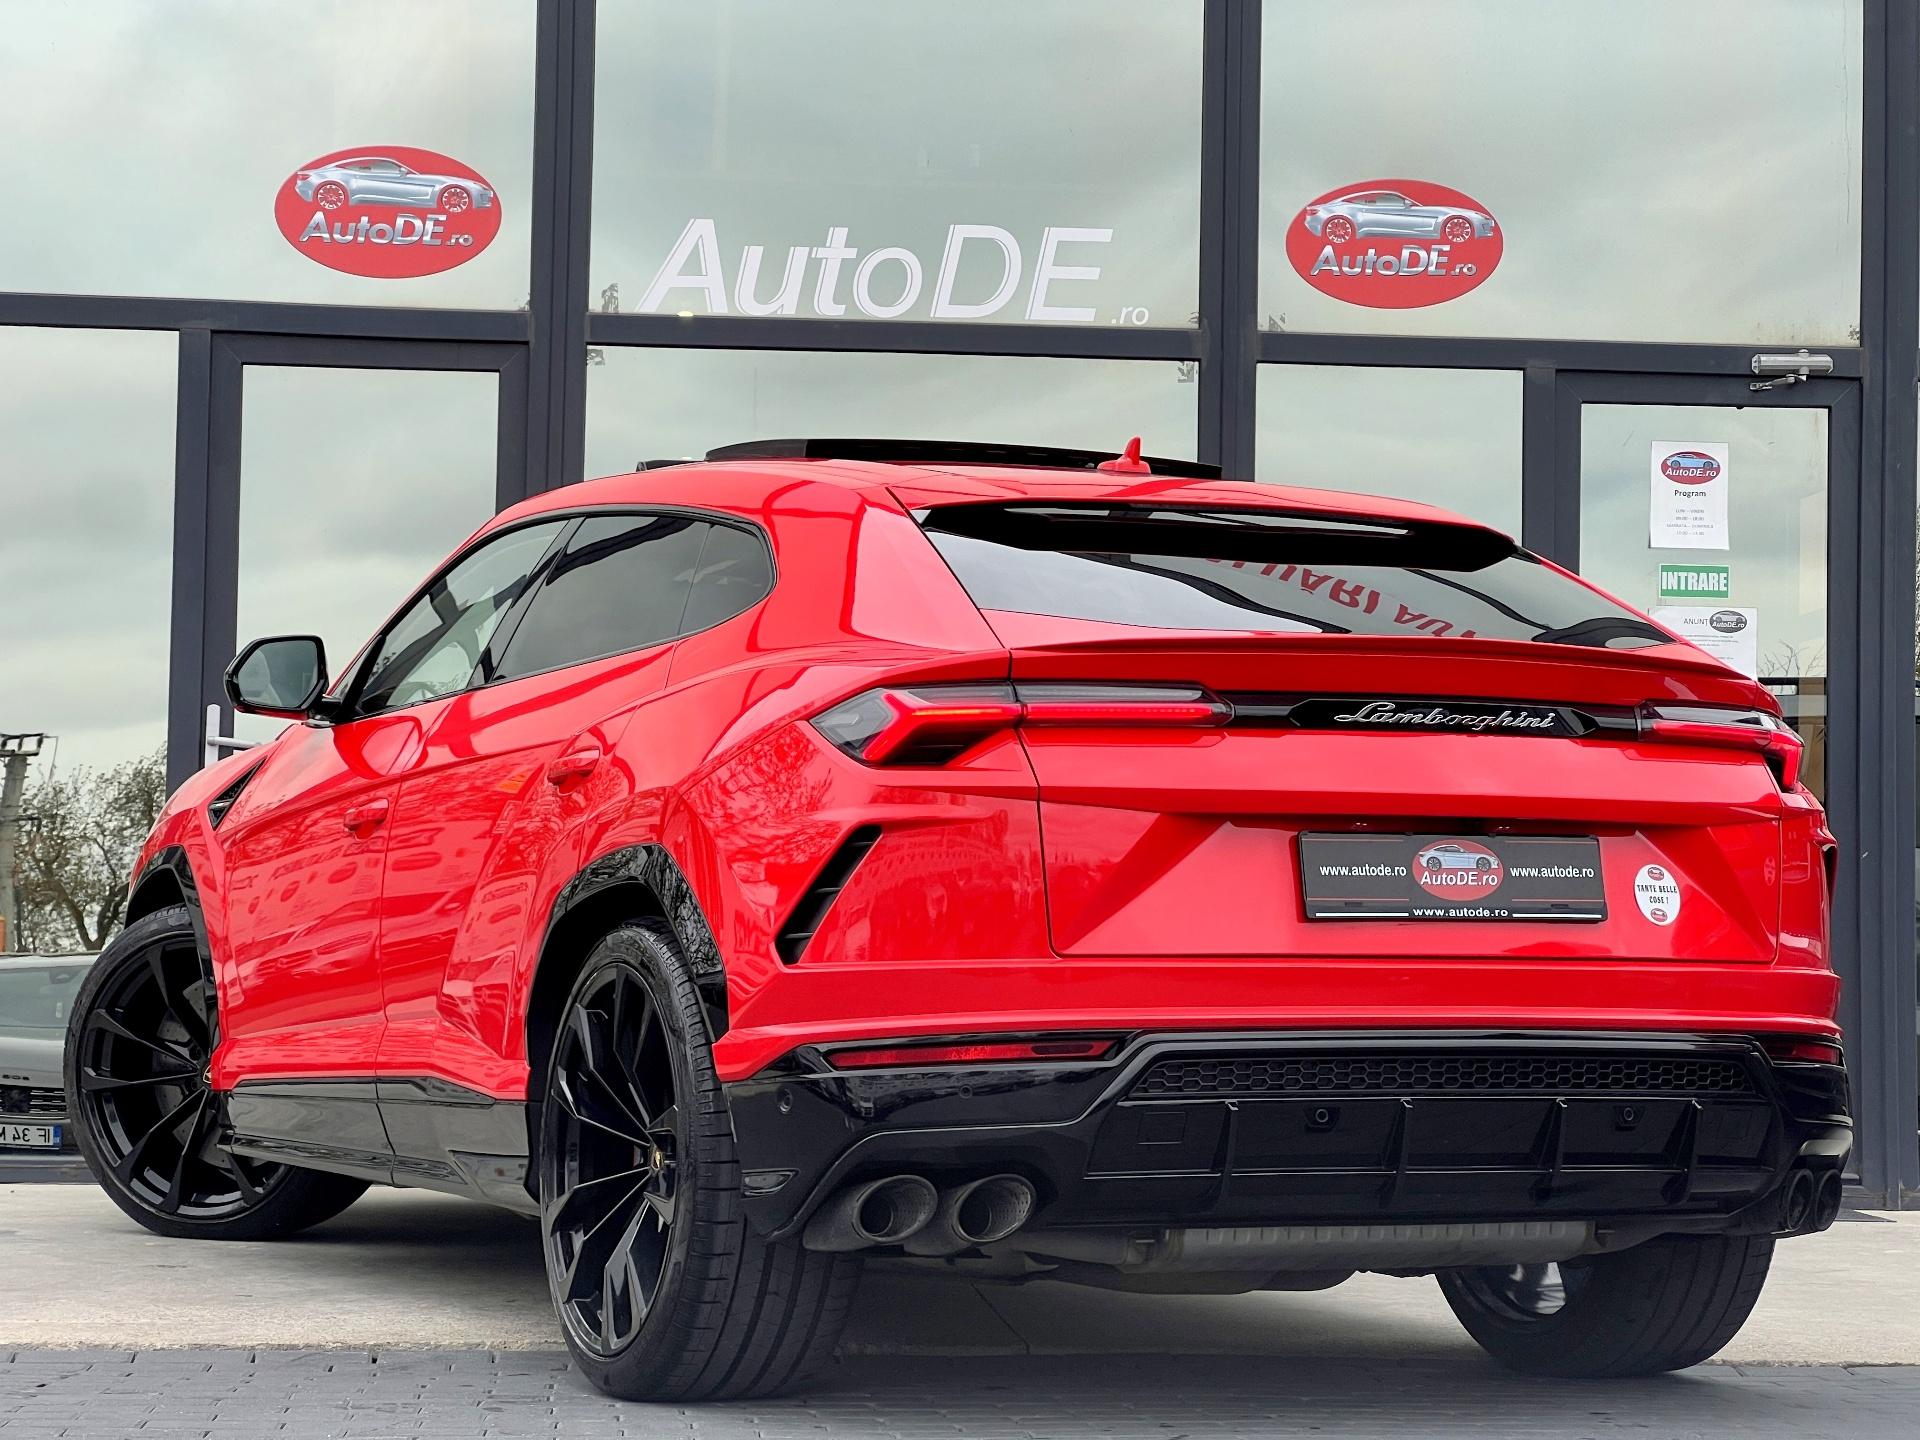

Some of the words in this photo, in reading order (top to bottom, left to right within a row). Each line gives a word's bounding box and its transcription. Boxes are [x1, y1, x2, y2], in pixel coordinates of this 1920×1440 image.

[1664, 467, 1717, 477] AutoDE.ro
[1674, 489, 1706, 498] Program
[1661, 571, 1727, 591] INTRARE
[1333, 702, 1554, 730] Lamborghini
[1319, 864, 1407, 876] www.autode.ro
[1510, 865, 1594, 878] www.autode.ro
[1420, 871, 1498, 886] AutoDE.ro
[1637, 884, 1657, 893] TANTE
[1659, 885, 1677, 893] BELLE
[1649, 896, 1665, 904] COSE
[1412, 908, 1508, 917] www.autode.ro
